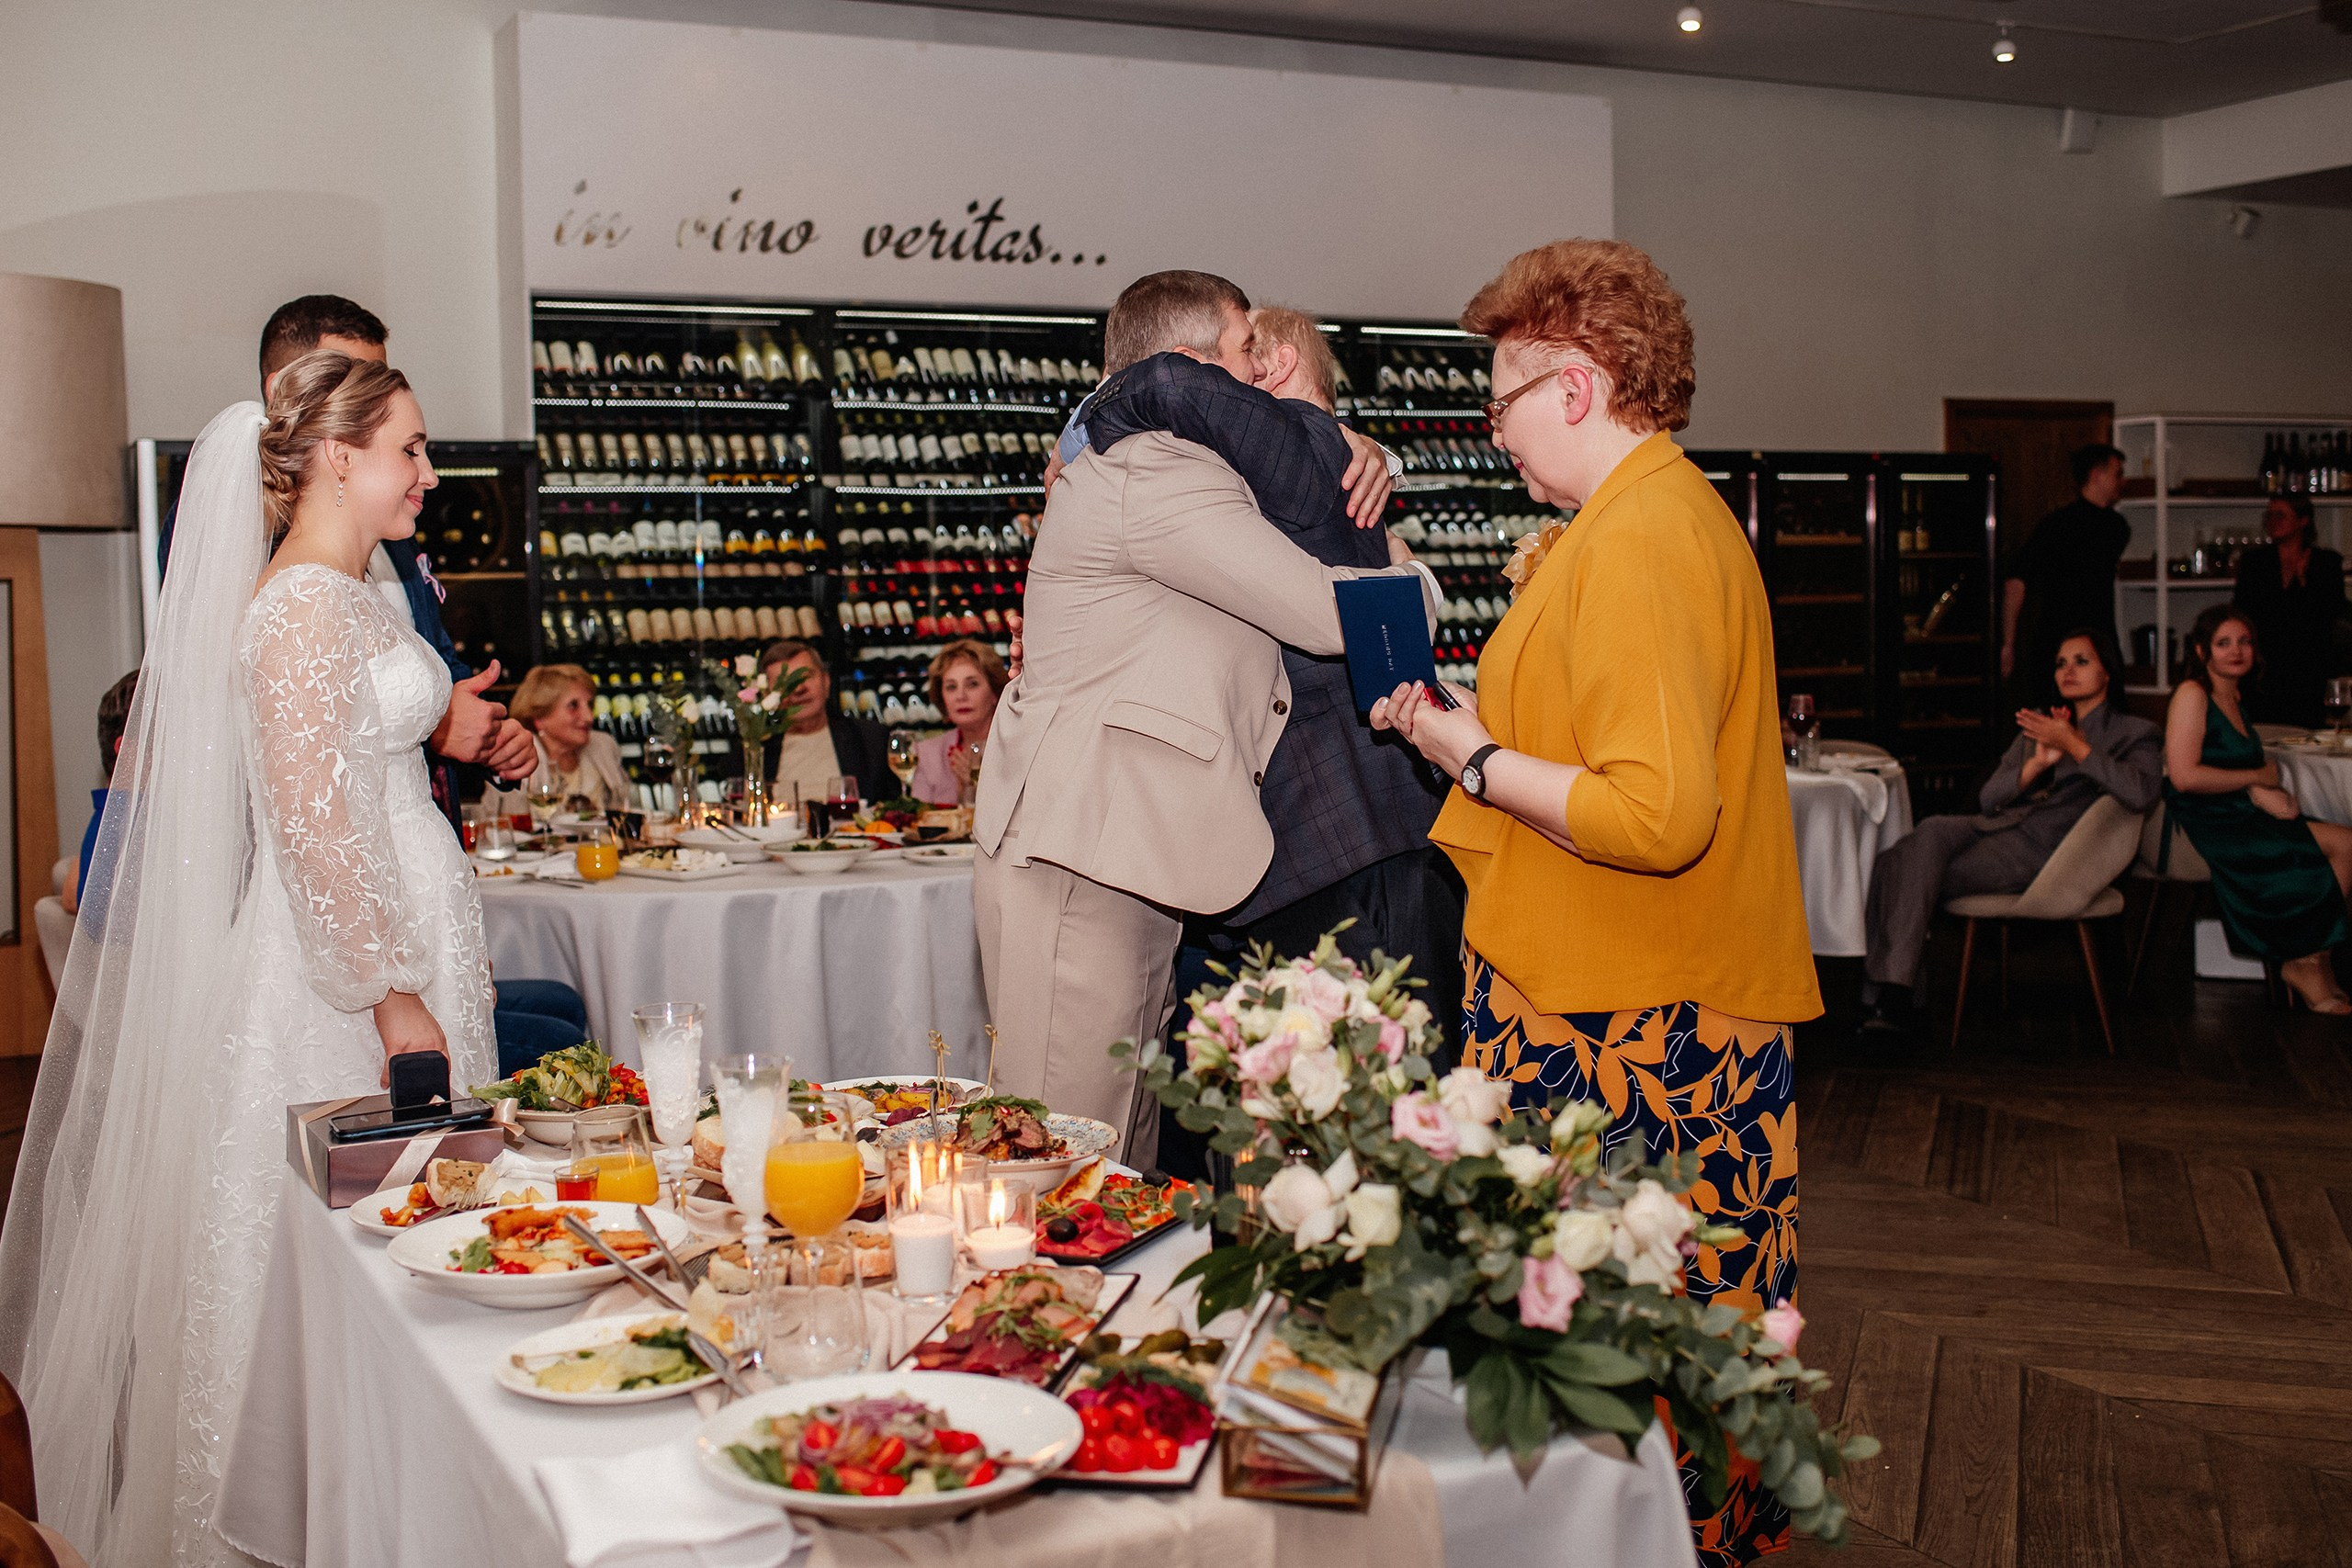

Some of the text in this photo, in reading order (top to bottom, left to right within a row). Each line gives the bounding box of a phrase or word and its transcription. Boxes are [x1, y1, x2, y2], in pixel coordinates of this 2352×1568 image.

[554, 180, 1105, 265] in vino veritas...
